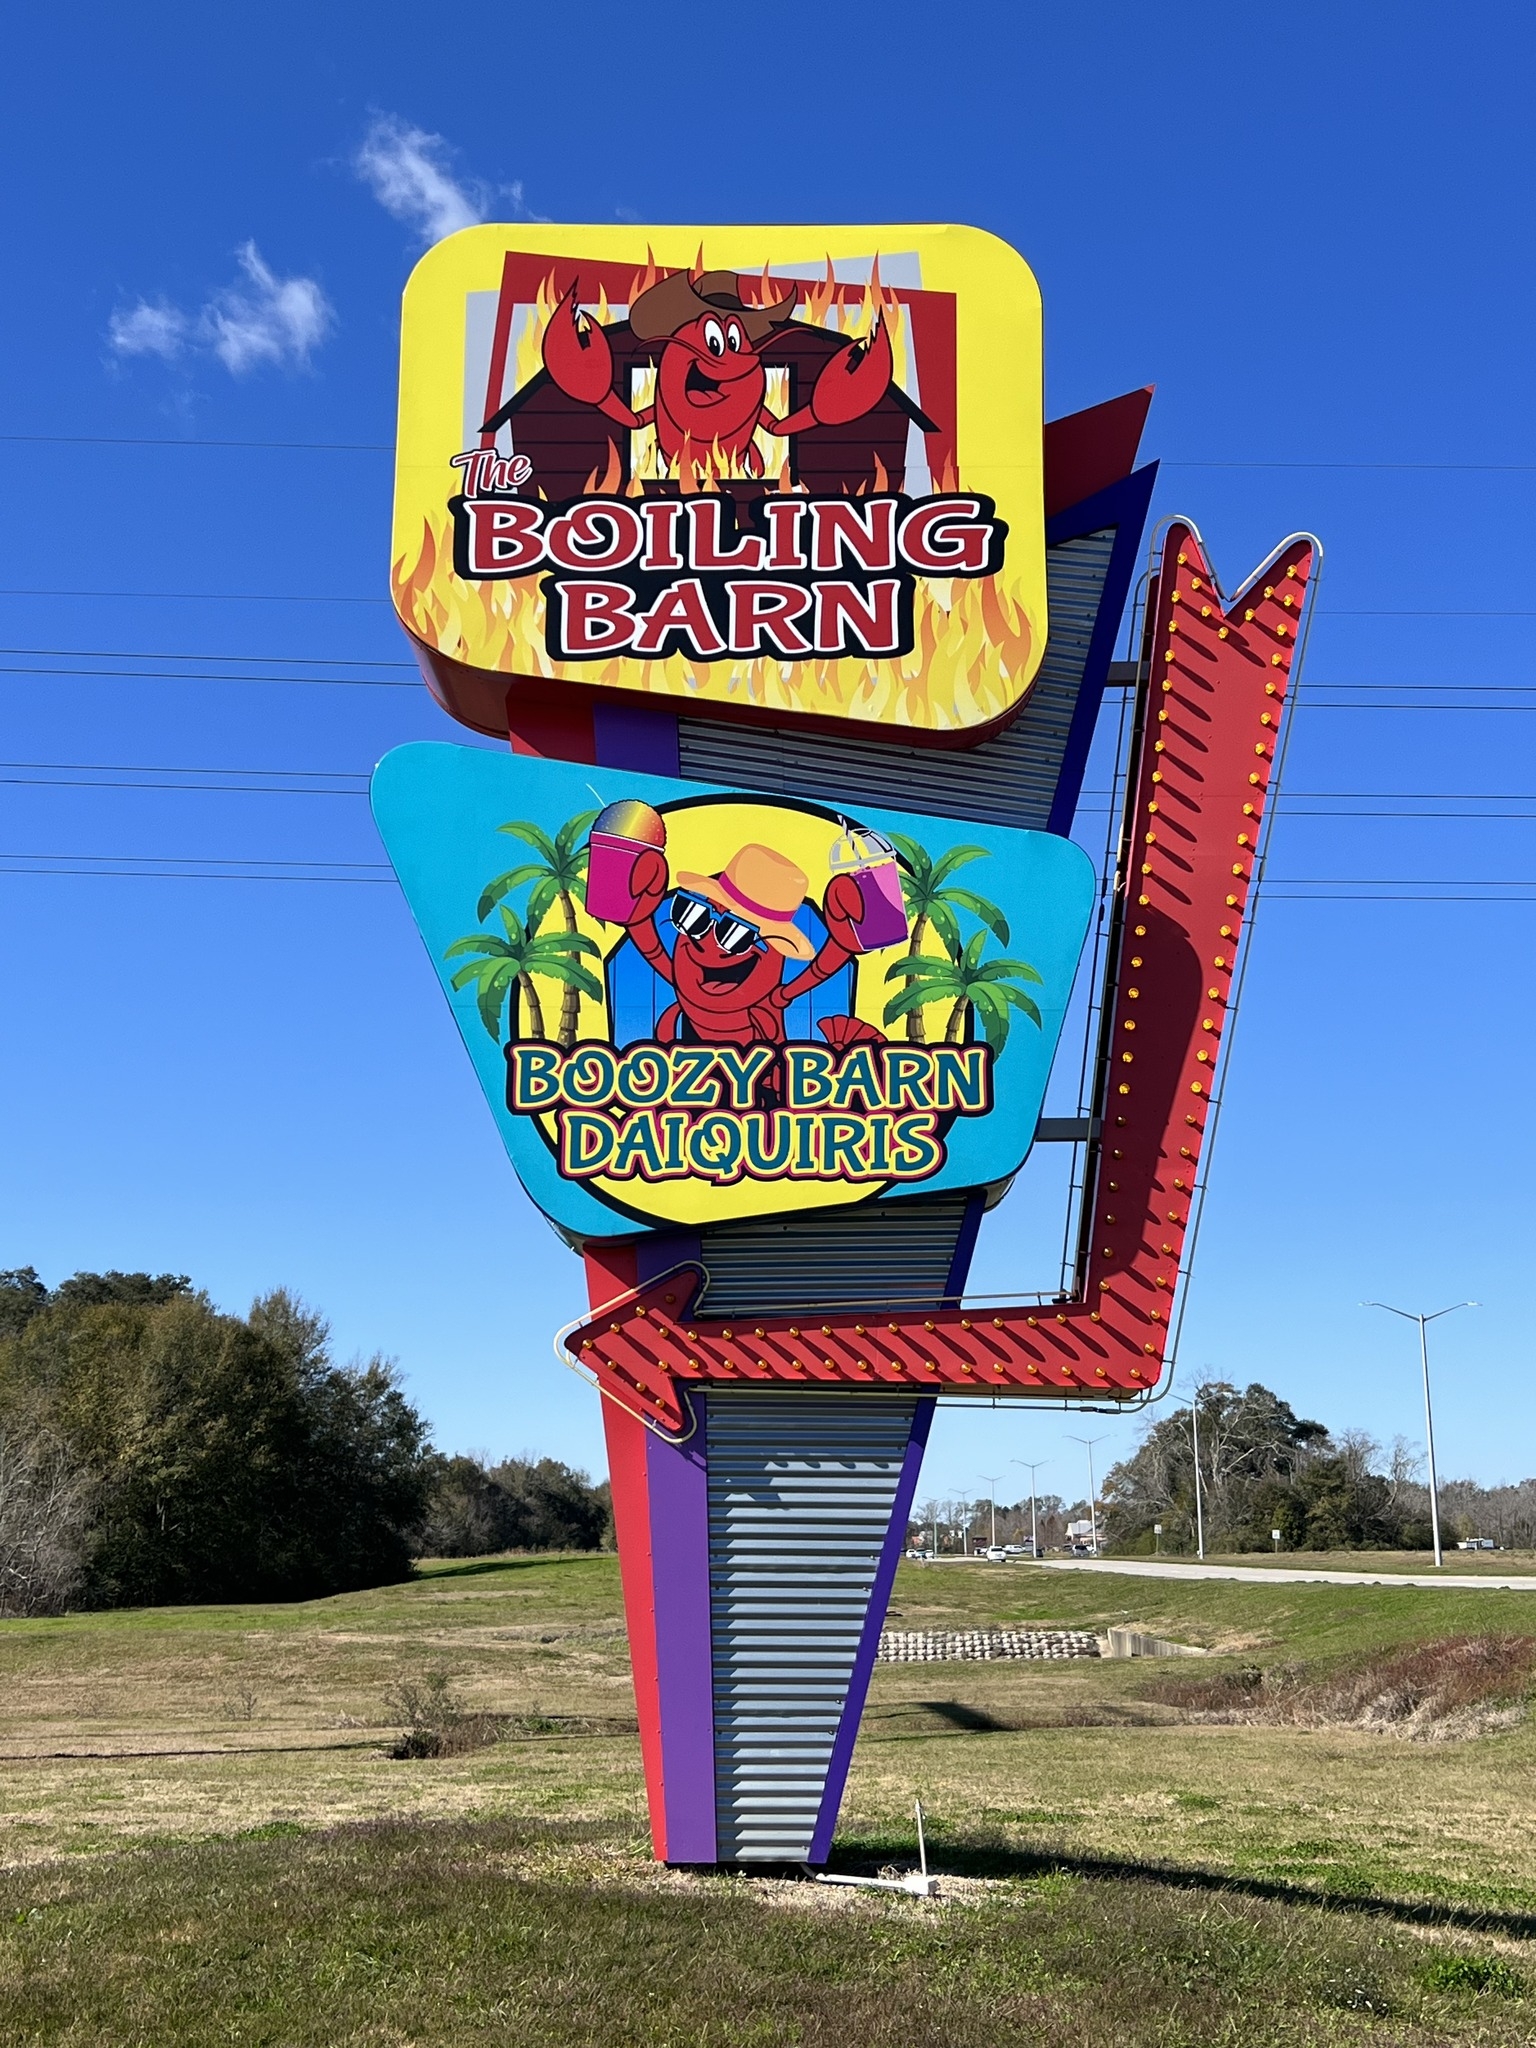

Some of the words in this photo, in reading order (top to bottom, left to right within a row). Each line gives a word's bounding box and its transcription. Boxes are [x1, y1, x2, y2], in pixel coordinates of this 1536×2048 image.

[452, 449, 533, 498] The
[466, 500, 996, 573] BOILING
[554, 578, 901, 655] BARN
[513, 1047, 773, 1109] BOOZY
[786, 1046, 987, 1111] BARN
[561, 1110, 942, 1179] DAIQUIRIS
